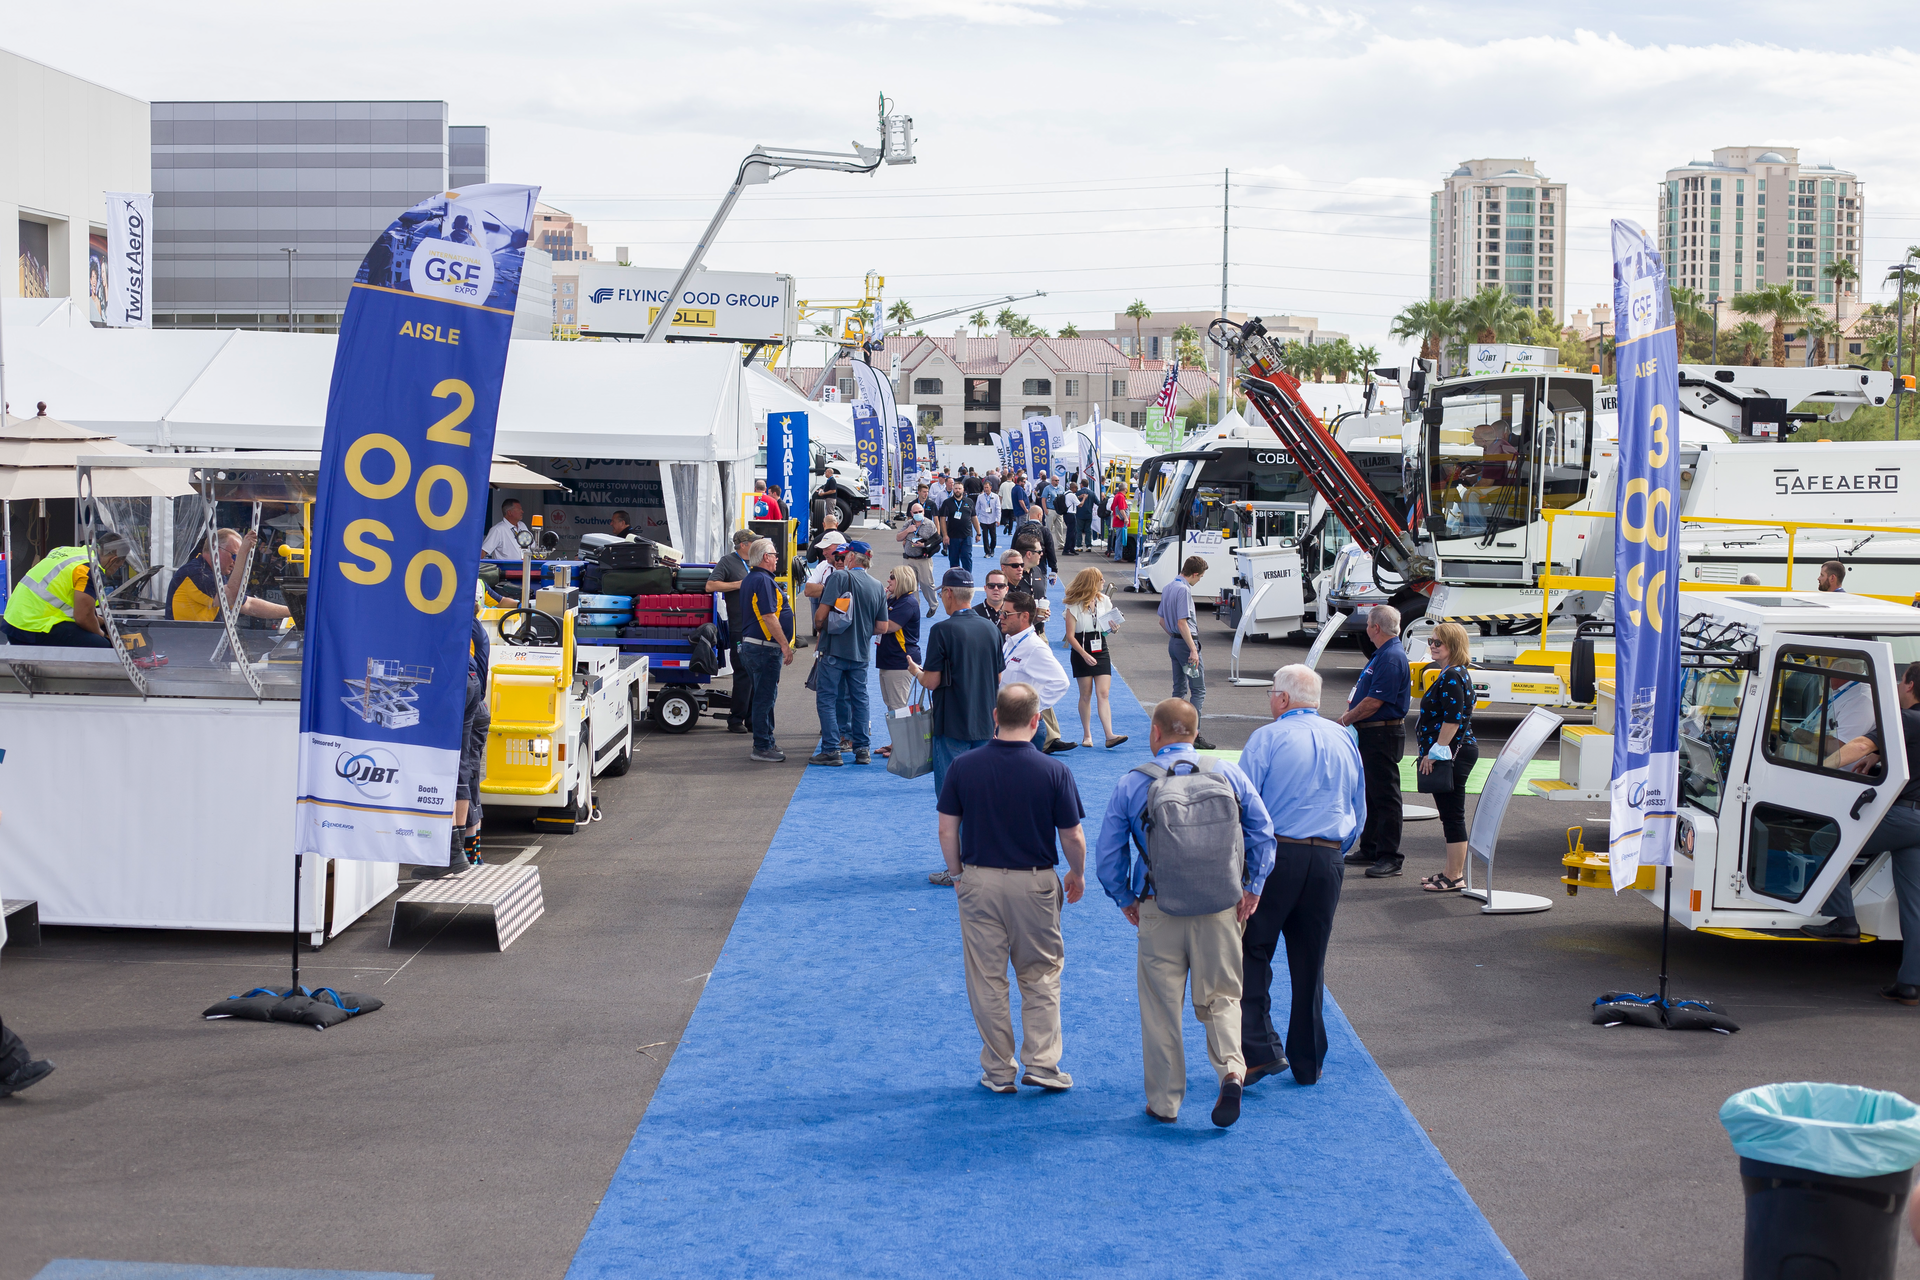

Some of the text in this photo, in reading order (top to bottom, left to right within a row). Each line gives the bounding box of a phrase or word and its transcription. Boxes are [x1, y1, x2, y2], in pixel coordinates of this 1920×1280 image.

[428, 250, 482, 266] INTERNATIONAL
[125, 214, 142, 322] TwistAero
[425, 258, 481, 289] GSE
[455, 286, 477, 296] EXPO
[683, 291, 720, 305] OOD
[725, 293, 780, 308] GROUP
[658, 311, 708, 323] OLL
[399, 320, 461, 345] AISLE
[1256, 452, 1299, 464] COBU
[578, 481, 658, 491] POWER STOW WOULD
[1775, 475, 1899, 495] SAFEAERO
[560, 491, 612, 503] THANK
[631, 497, 660, 505] AIRLINE
[1263, 569, 1291, 580] VERSALIFT
[1519, 588, 1559, 596] SAFEARO
[312, 737, 334, 748] Sponsored
[357, 766, 399, 784] JBT
[418, 784, 439, 794] Booth
